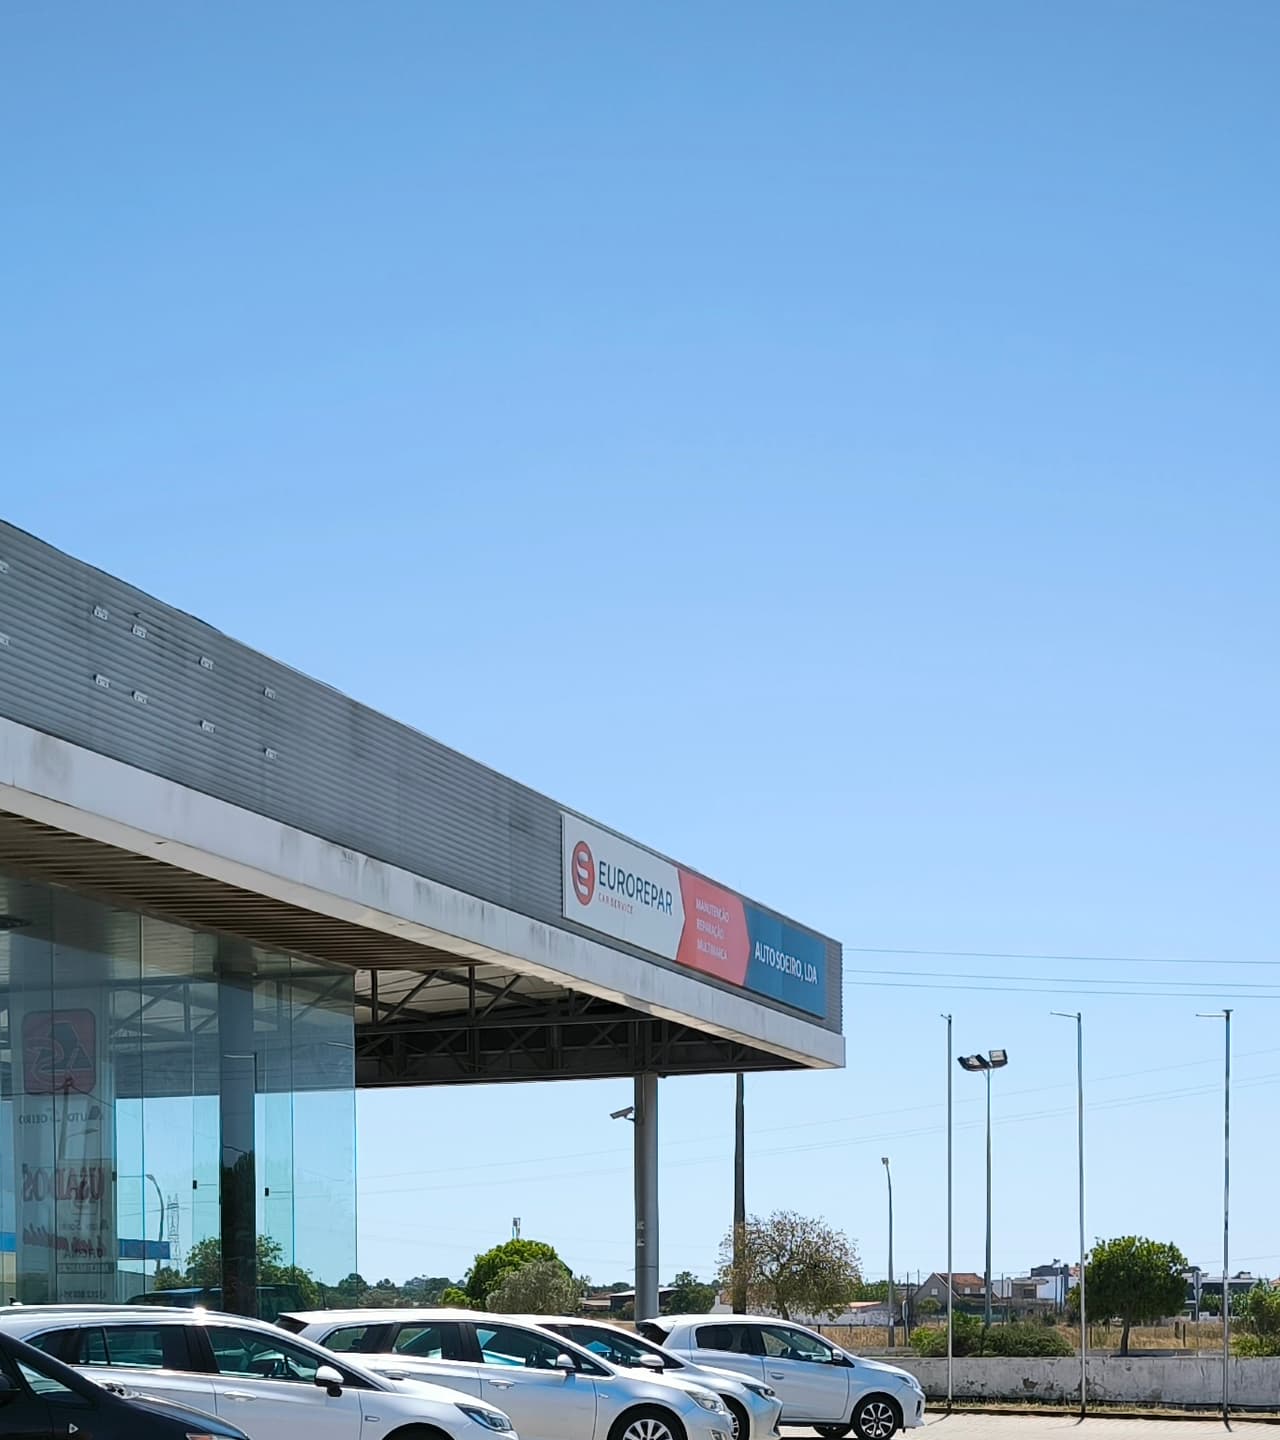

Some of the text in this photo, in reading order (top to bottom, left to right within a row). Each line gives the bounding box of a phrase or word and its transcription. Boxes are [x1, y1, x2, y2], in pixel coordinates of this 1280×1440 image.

[599, 860, 673, 917] EUROREPAR
[754, 941, 818, 985] AUTO SOEIRO, LDA
